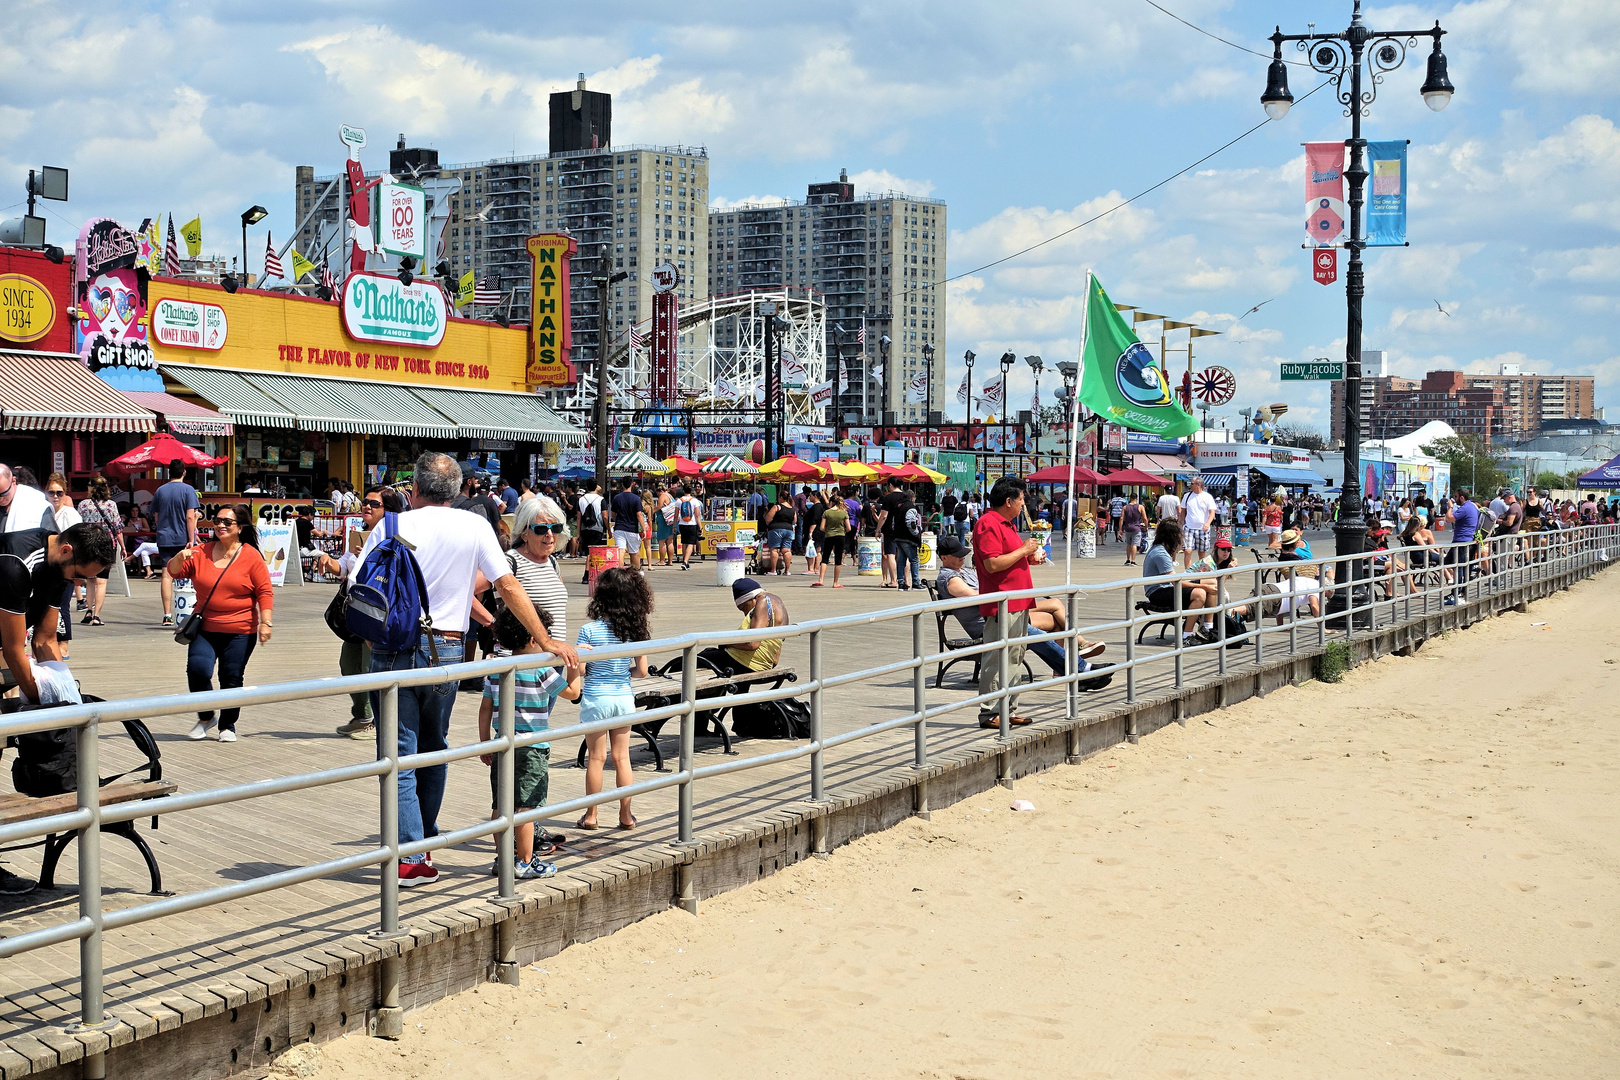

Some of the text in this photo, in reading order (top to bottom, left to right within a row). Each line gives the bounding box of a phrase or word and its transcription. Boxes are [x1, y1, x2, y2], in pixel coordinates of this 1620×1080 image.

[392, 197, 412, 206] FOR OVER
[392, 206, 414, 227] 100
[392, 228, 414, 240] YEARS
[530, 239, 566, 247] ORIGINAL
[2, 288, 34, 308] SINCE
[403, 288, 421, 297] Since 1916
[353, 278, 438, 327] Nathan's
[539, 248, 556, 364] NATHANS
[6, 309, 32, 328] 1934
[162, 302, 199, 326] Nathan's
[207, 308, 220, 319] GIFT
[207, 320, 220, 328] SHOP
[160, 327, 200, 344] CONEY ISLAND
[383, 329, 412, 338] FAMOUS
[125, 348, 154, 366] SHOP
[278, 344, 490, 380] THE FLAVOR OF NEW YORK SINCE 1916
[529, 372, 566, 381] FRANKFURTERS
[1282, 363, 1340, 376] Ruby Jacobs
[1124, 410, 1170, 429] ORIGINALS
